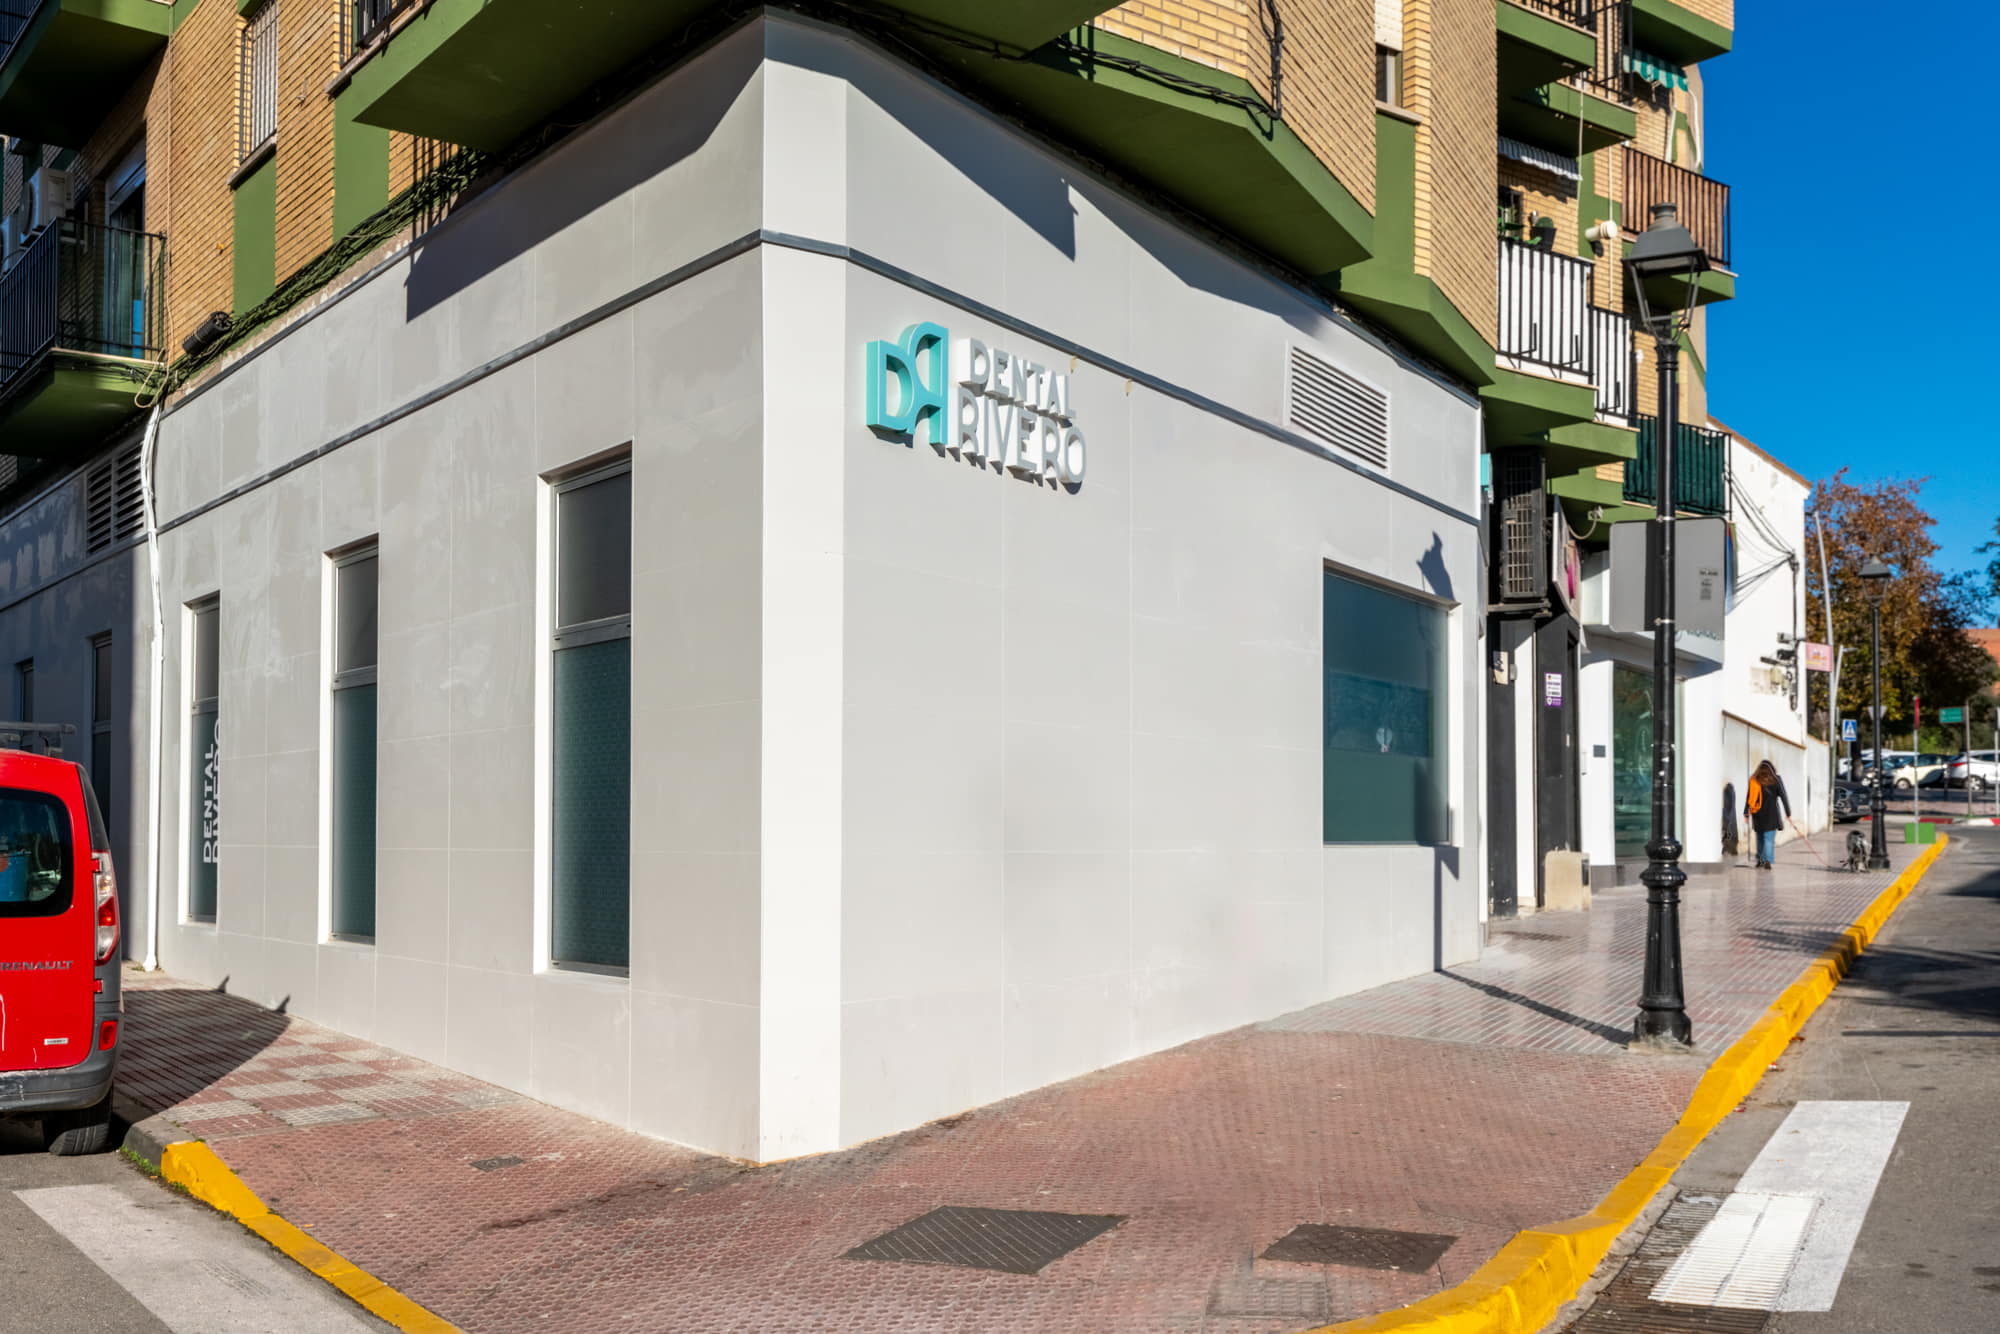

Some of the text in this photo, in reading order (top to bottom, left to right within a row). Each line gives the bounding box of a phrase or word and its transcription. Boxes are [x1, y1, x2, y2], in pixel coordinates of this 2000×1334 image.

[957, 337, 1076, 419] DENTAL
[948, 385, 1086, 484] RIVERO
[203, 743, 214, 863] DENTAL
[0, 960, 74, 971] RENAULT
